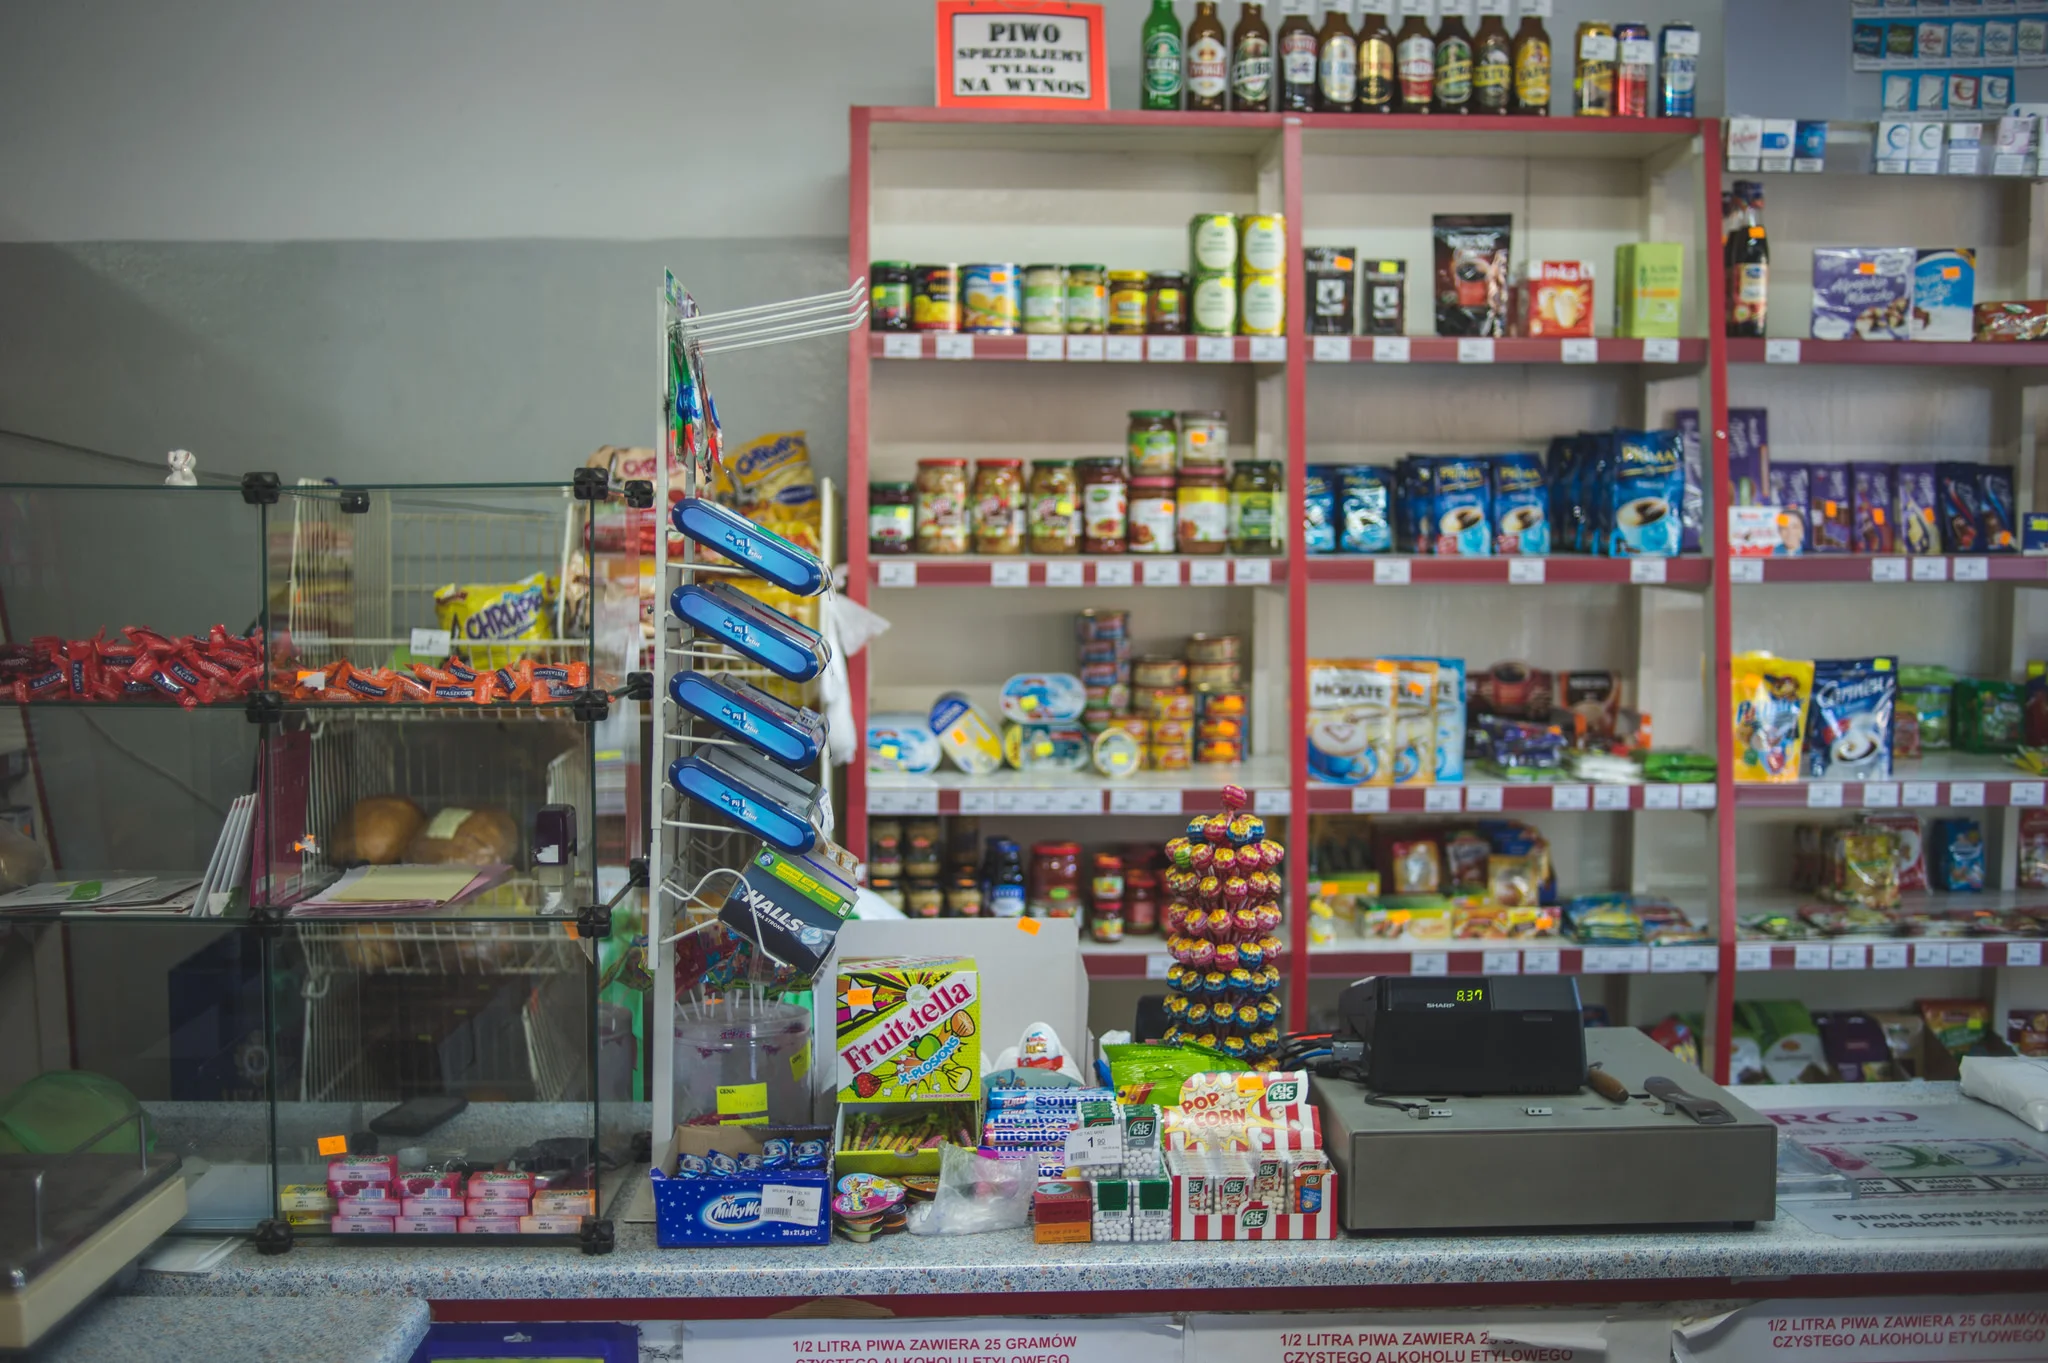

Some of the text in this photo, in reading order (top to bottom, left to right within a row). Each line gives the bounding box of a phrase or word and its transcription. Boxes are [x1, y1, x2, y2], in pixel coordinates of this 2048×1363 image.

[988, 22, 1061, 44] PIWO
[957, 47, 1084, 64] SPRZEDAJEMY
[987, 63, 1055, 75] TYLKO
[959, 77, 1086, 95] NA WYNOS
[32, 671, 63, 688] RACZKI
[73, 662, 82, 692] RACZKI
[173, 664, 196, 684] RACZKI
[1314, 683, 1384, 701] MOKATE
[741, 889, 804, 931] HALLS
[764, 917, 785, 933] STRONG
[899, 1036, 960, 1085] X-PLOSIONS
[1273, 1089, 1294, 1100] tac
[1276, 1083, 1294, 1093] tic
[1181, 1092, 1220, 1114] POP
[1194, 1108, 1246, 1127] CORN
[995, 1130, 1070, 1141] mentos
[1134, 1128, 1149, 1136] tac
[1088, 1136, 1094, 1148] 1
[787, 1195, 794, 1206] 1
[1246, 1218, 1263, 1226] tac
[1250, 1212, 1264, 1220] tic
[1832, 1212, 1911, 1222] Palenie
[1918, 1209, 2019, 1222] poważnie
[1876, 1221, 1955, 1230] osobom
[1767, 1318, 1788, 1332] 1/2
[1791, 1317, 1835, 1331] LITRA
[1841, 1316, 1880, 1329] PIWA
[1883, 1314, 1955, 1328] ZAWIERA
[1959, 1314, 1976, 1327] 25
[793, 1333, 1078, 1353] 1/2 LITRA PIWA ZAWIERA 25 GRAMÓW
[1280, 1334, 1302, 1347] 1/2
[1306, 1333, 1354, 1347] LITRA
[1358, 1332, 1399, 1346] PIWA
[1402, 1332, 1476, 1346] ZAWIERA
[1772, 1329, 2046, 1348] CZYSTEGO ALKOHOLU ETYLOWEGO
[1283, 1349, 1573, 1363] CZYSTEGO ALKOHOLU ETYLOWEGO
